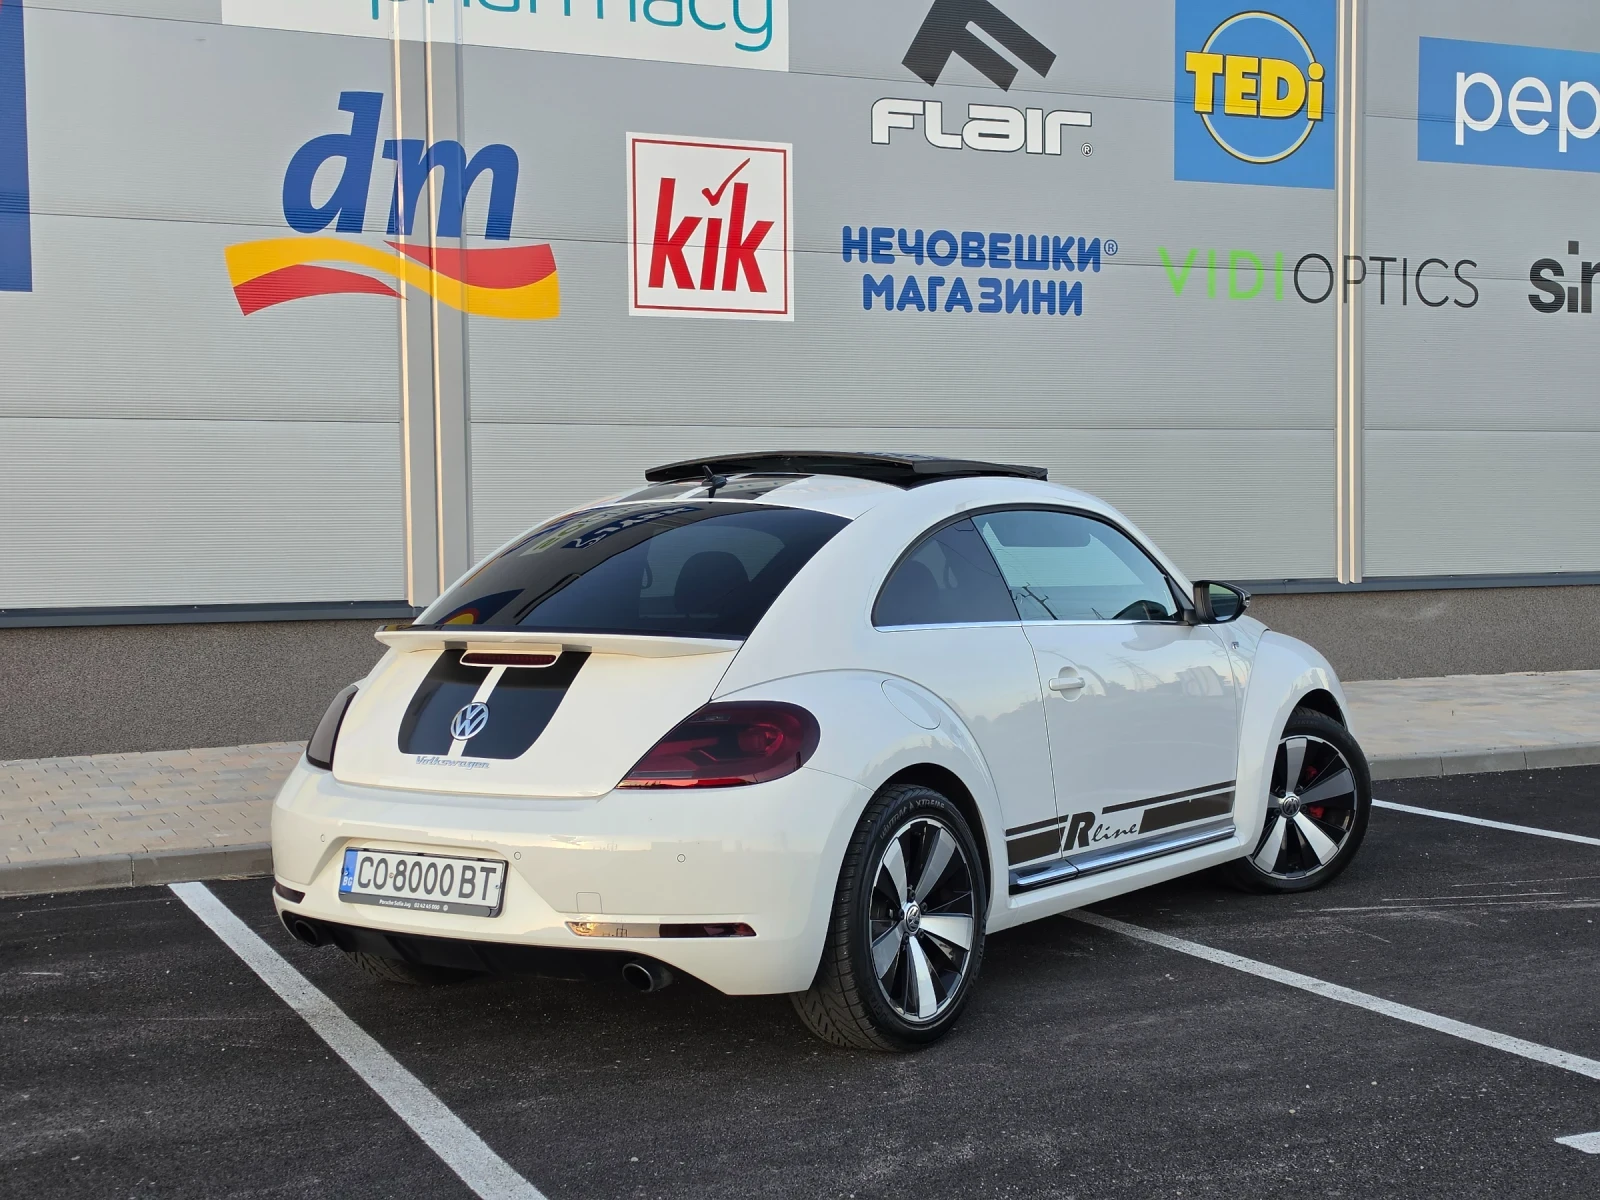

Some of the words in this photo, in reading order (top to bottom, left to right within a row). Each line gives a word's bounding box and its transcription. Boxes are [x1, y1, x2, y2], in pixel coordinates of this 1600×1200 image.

[1185, 51, 1325, 121] TEDi
[1455, 72, 1600, 152] pep
[283, 91, 519, 241] dm
[648, 160, 775, 293] kik
[863, 273, 1083, 316] МАГАЗИНИ
[416, 756, 490, 770] Volkswagen
